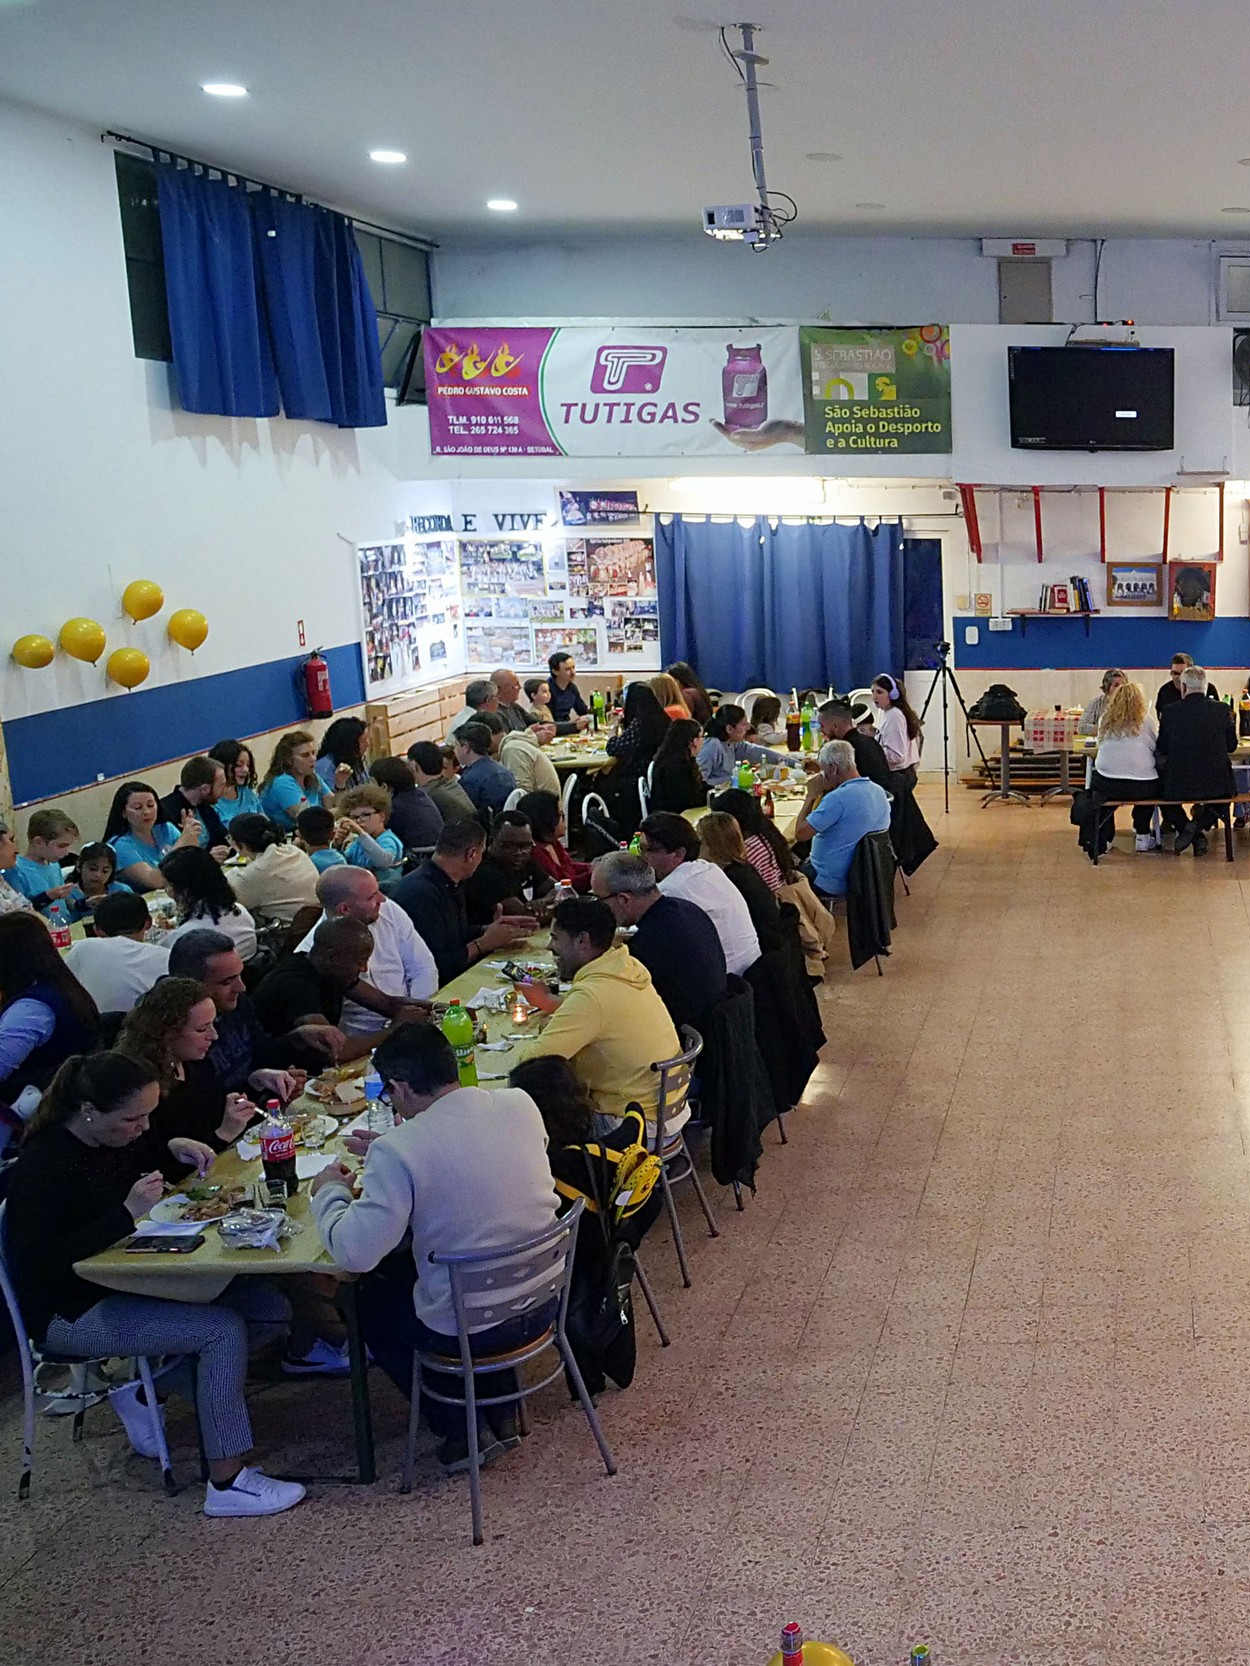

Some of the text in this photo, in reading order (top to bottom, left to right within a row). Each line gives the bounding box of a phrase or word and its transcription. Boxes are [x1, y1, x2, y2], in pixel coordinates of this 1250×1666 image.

[437, 386, 529, 396] PEDRO GUSTAVO COSTA
[560, 402, 700, 424] TUTIGAS
[825, 405, 920, 418] São Sebastião
[447, 415, 470, 424] TLM.
[470, 415, 486, 424] 910
[448, 425, 469, 434] TEL.
[487, 425, 503, 434] 724
[825, 420, 942, 436] Apoia o Desporto
[826, 435, 898, 448] e a Cultura
